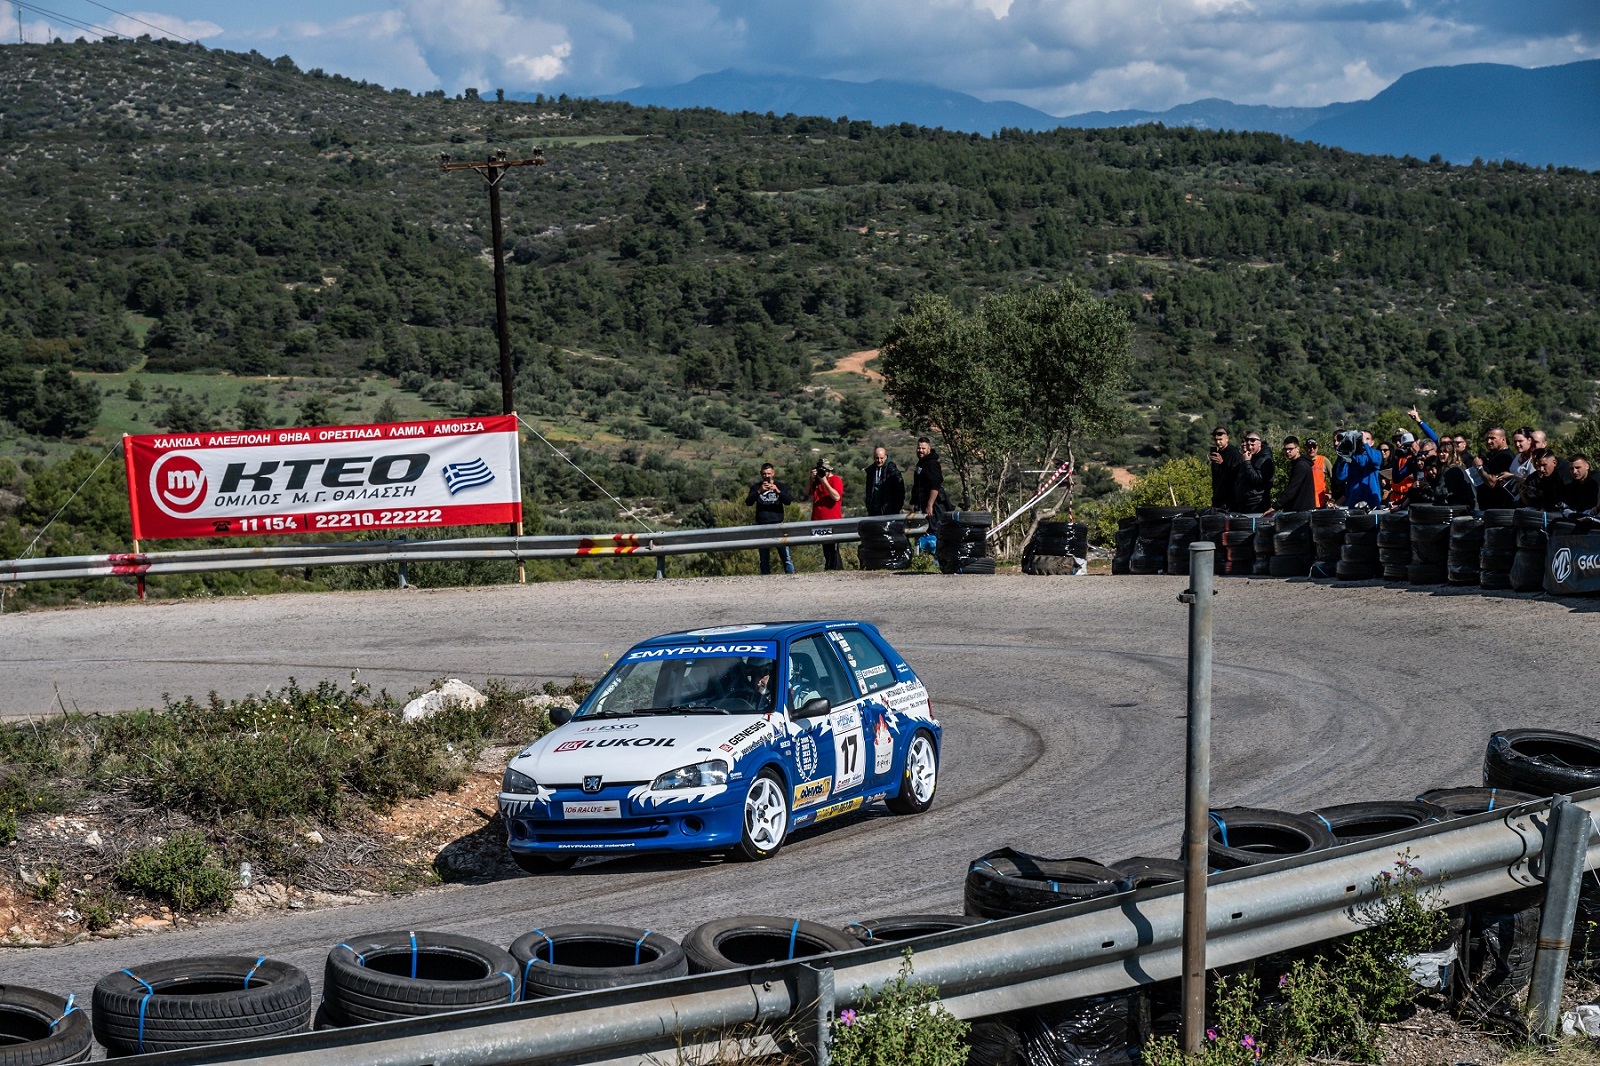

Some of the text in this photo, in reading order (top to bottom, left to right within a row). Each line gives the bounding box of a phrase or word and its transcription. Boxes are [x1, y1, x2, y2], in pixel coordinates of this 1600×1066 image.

[154, 422, 485, 449] ΧΑΛΚΙΔΑ ΑΛΕΞ/ΠΟΛΗ ΘΗΒΑ ΟΡΕΣΤΙΑΔΑ ΛΑΜΙΑ ΑΜΦΙΣΣΑ
[218, 453, 431, 493] ΚΤΕΟ
[214, 485, 417, 507] ΟΜΙΛΟΣ Μ. Γ. ΘΑΛΑΣΣΗ
[239, 509, 442, 532] 11 154 22210.22222
[627, 645, 768, 660] ΣΜΥΡΝΑΙΟΣ
[577, 723, 640, 733] ALESSO
[728, 720, 767, 746] GENESIS
[581, 737, 676, 749] LUKOIL
[840, 734, 858, 775] 17
